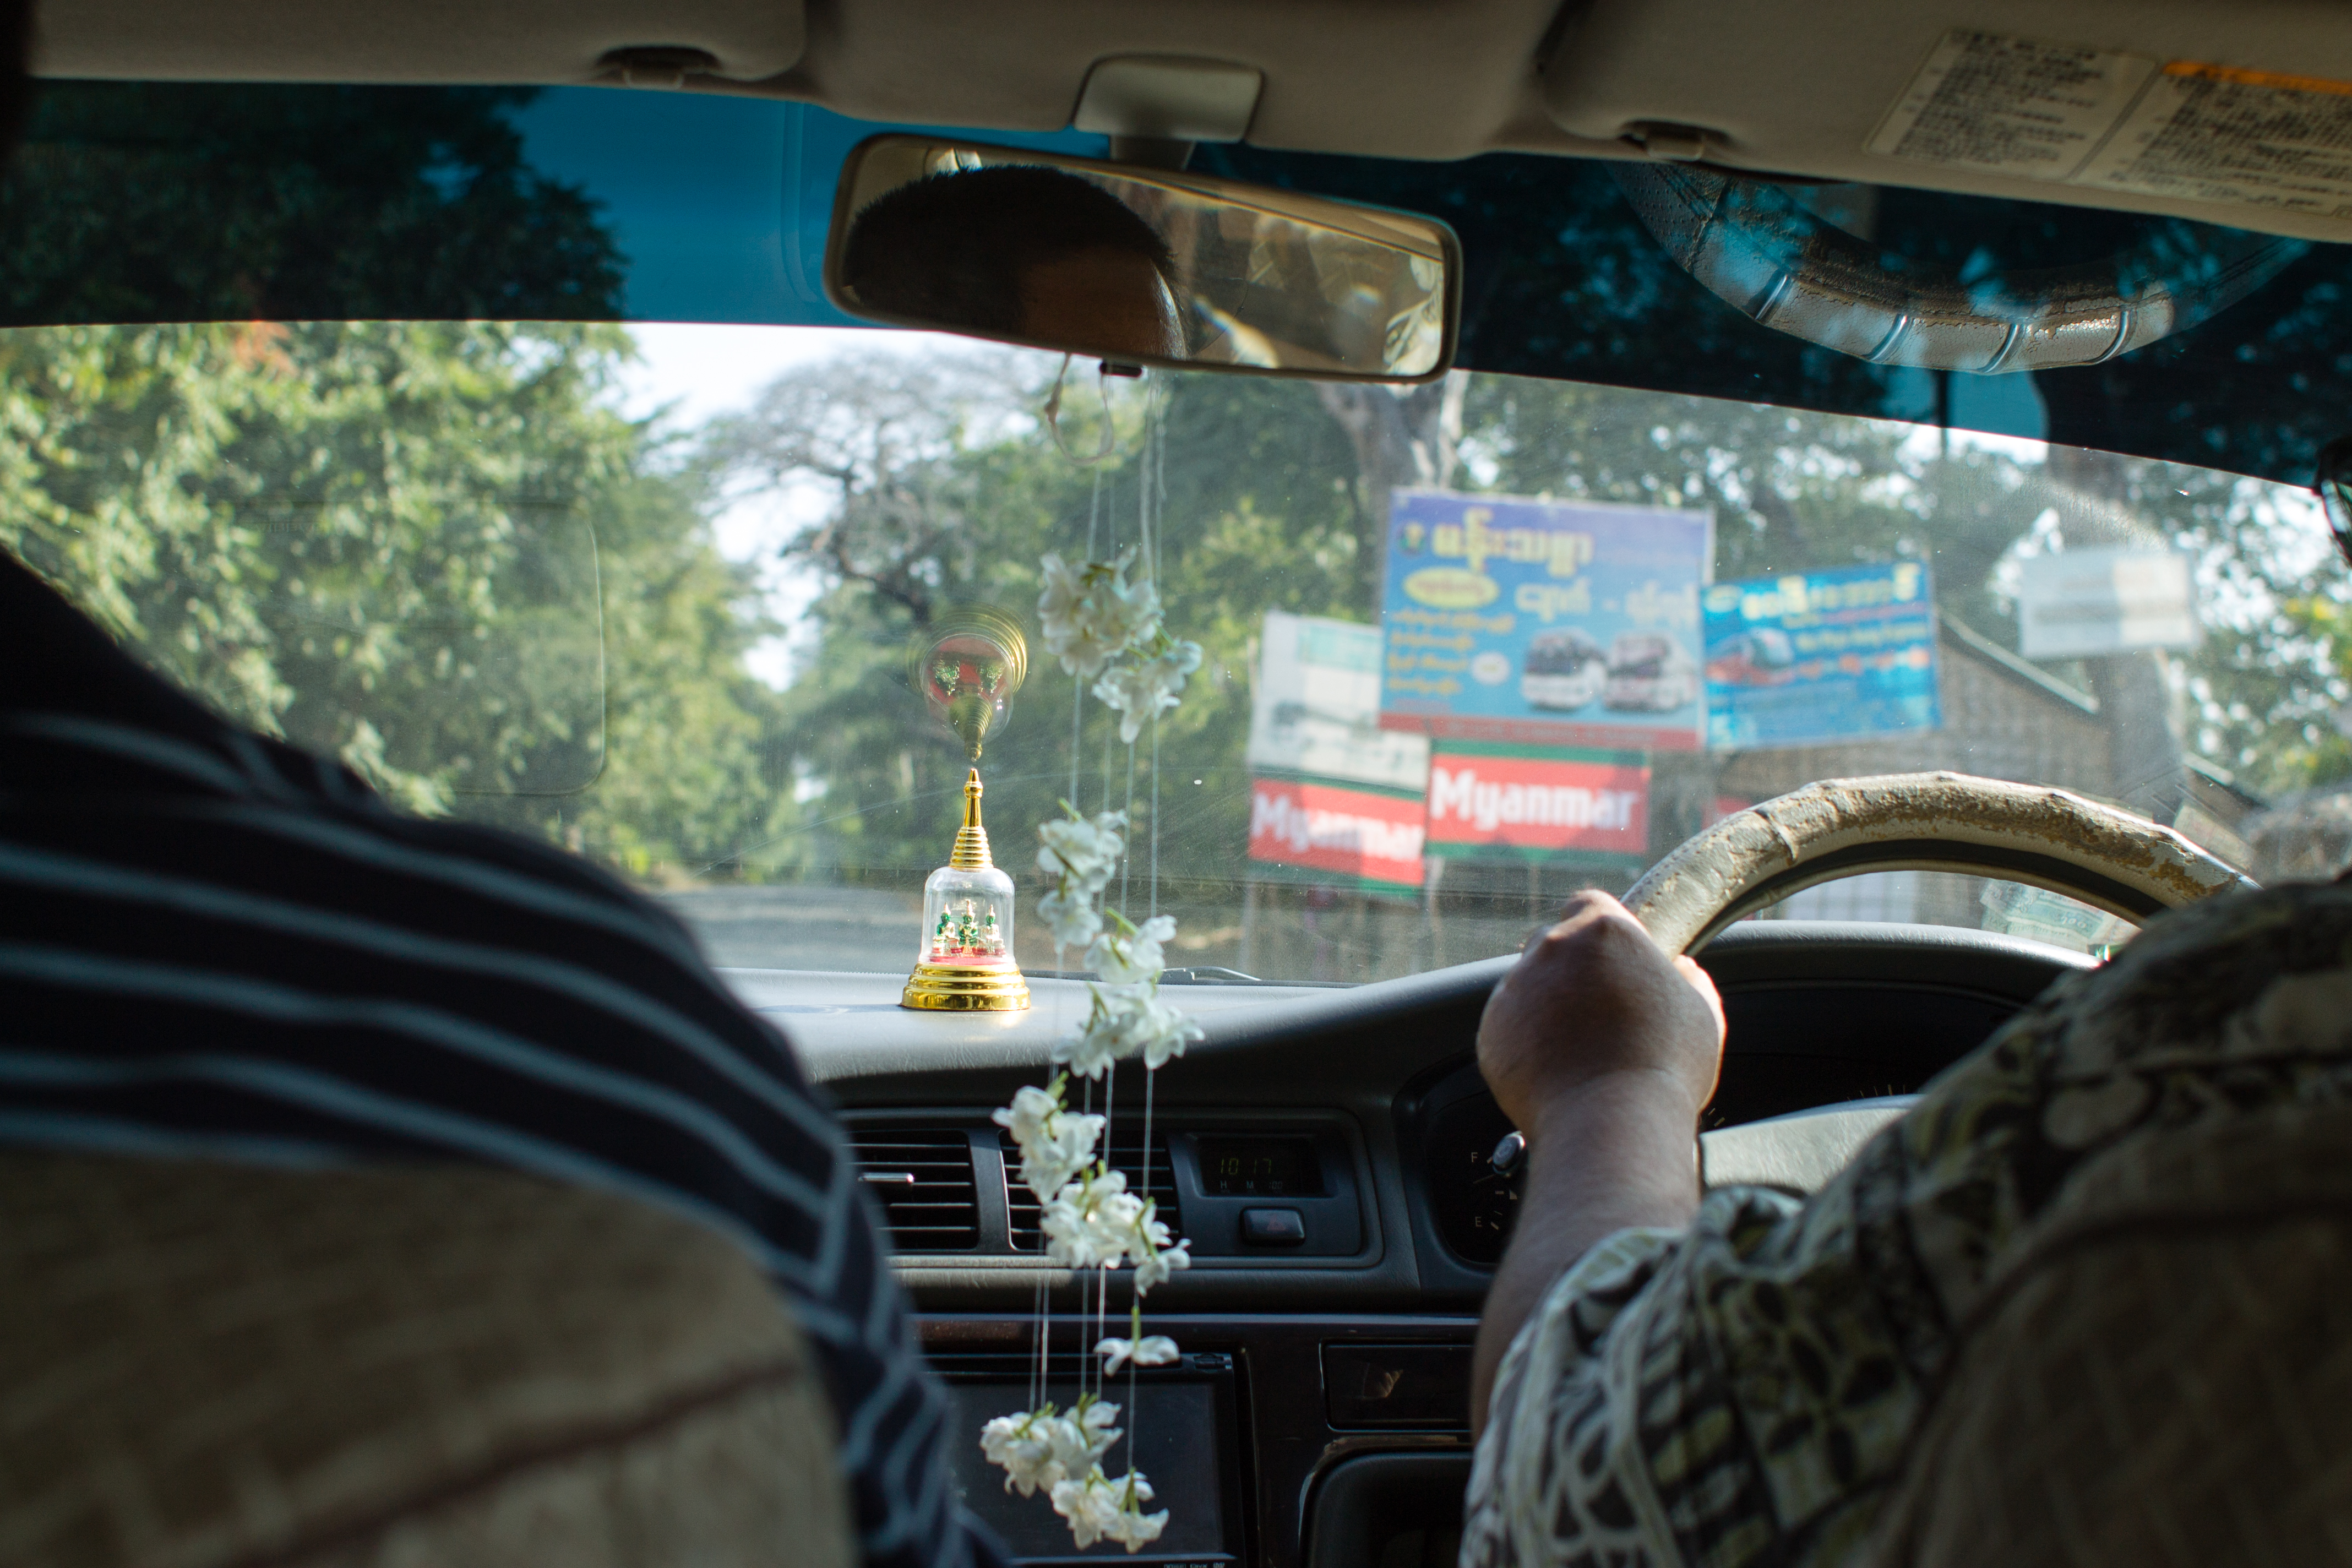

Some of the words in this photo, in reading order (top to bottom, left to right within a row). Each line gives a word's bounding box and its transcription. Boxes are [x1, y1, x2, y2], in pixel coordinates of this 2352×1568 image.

[1431, 768, 1635, 830] Myanmar
[1471, 1152, 1478, 1163] F
[1219, 1180, 1228, 1189] H
[1246, 1180, 1254, 1189] M
[1475, 1216, 1482, 1227] E
